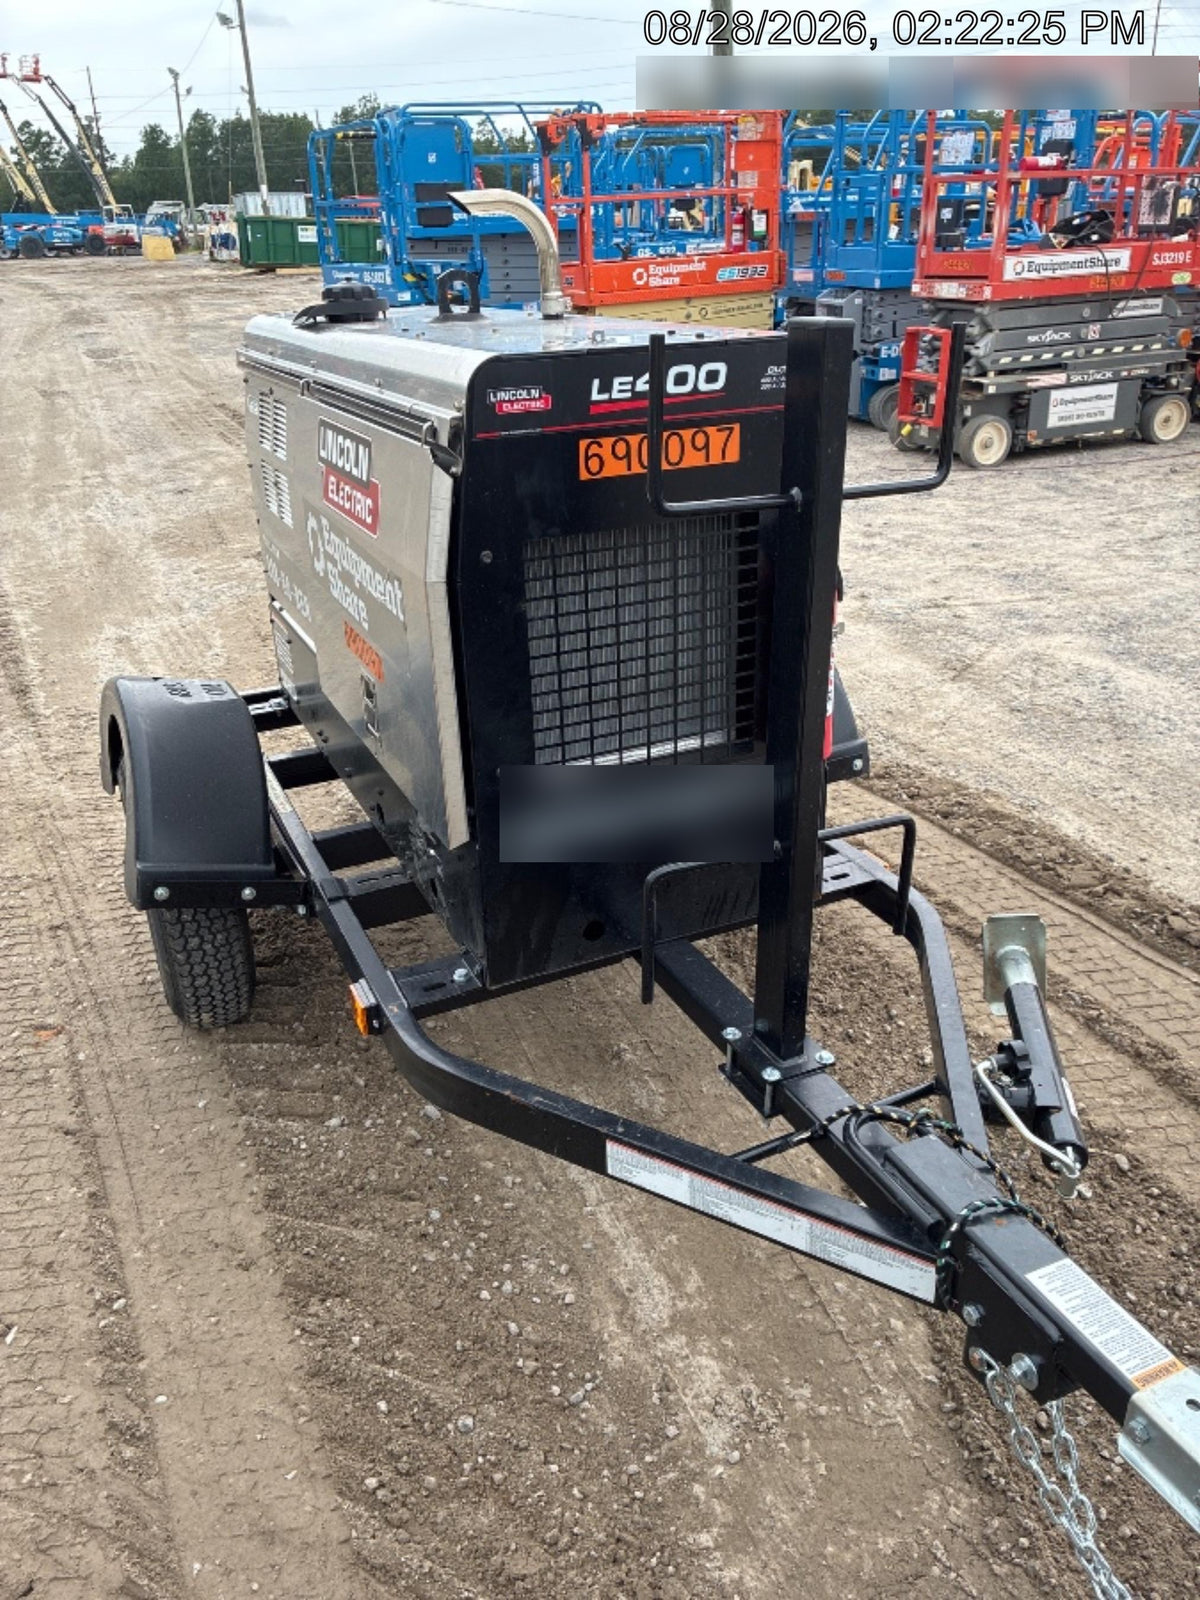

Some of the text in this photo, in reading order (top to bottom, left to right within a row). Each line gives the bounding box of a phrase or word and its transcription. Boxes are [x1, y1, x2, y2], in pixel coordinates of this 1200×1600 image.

[648, 261, 706, 276] Equipment
[1026, 256, 1121, 274] EquipmentShare
[717, 265, 767, 281] ES1932
[648, 276, 680, 287] Share
[1026, 329, 1072, 343] SKYJACK
[1069, 369, 1114, 383] SKYJACK
[489, 388, 540, 403] LINCOLN
[502, 400, 545, 411] ELECTRIC
[319, 425, 369, 482] LINCOLN
[327, 475, 373, 524] ELECTRIC
[319, 515, 404, 623] Equipment
[326, 561, 369, 632] Share
